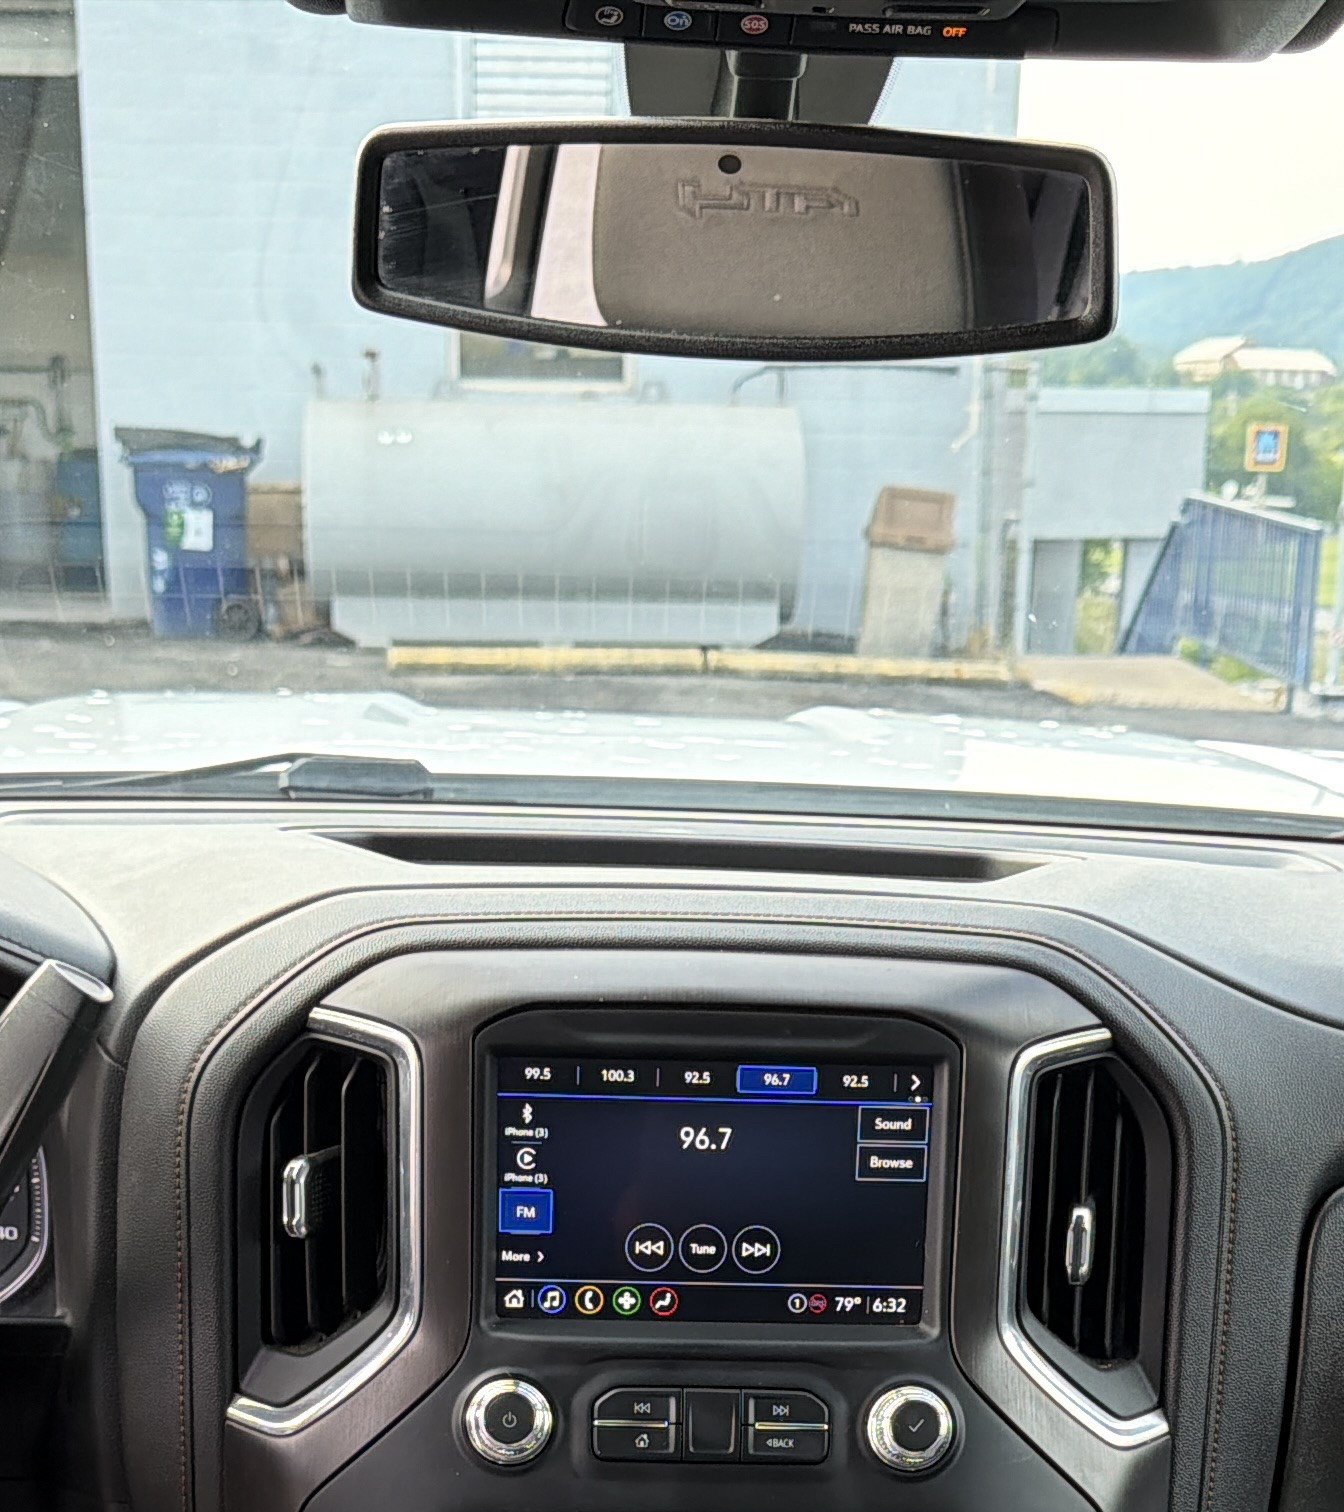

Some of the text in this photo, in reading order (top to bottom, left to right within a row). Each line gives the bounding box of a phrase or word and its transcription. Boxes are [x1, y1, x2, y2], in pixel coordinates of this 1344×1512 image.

[744, 20, 765, 29] SOS
[848, 23, 880, 34] PASS
[883, 24, 903, 35] AIR
[906, 25, 932, 36] BAG
[943, 27, 967, 38] OFF
[524, 1067, 551, 1081] 99.5
[601, 1069, 635, 1083] 100.3
[684, 1071, 711, 1085] 92.5
[763, 1073, 791, 1087] 96.7
[842, 1075, 869, 1088] 92.5
[875, 1118, 912, 1131] Sound
[679, 1126, 732, 1151] 96.7
[869, 1156, 913, 1169] Browse
[516, 1206, 536, 1219] FM
[690, 1243, 716, 1255] Tune
[501, 1250, 531, 1263] More
[872, 1298, 906, 1313] 6:32
[773, 1438, 795, 1448] BACK
